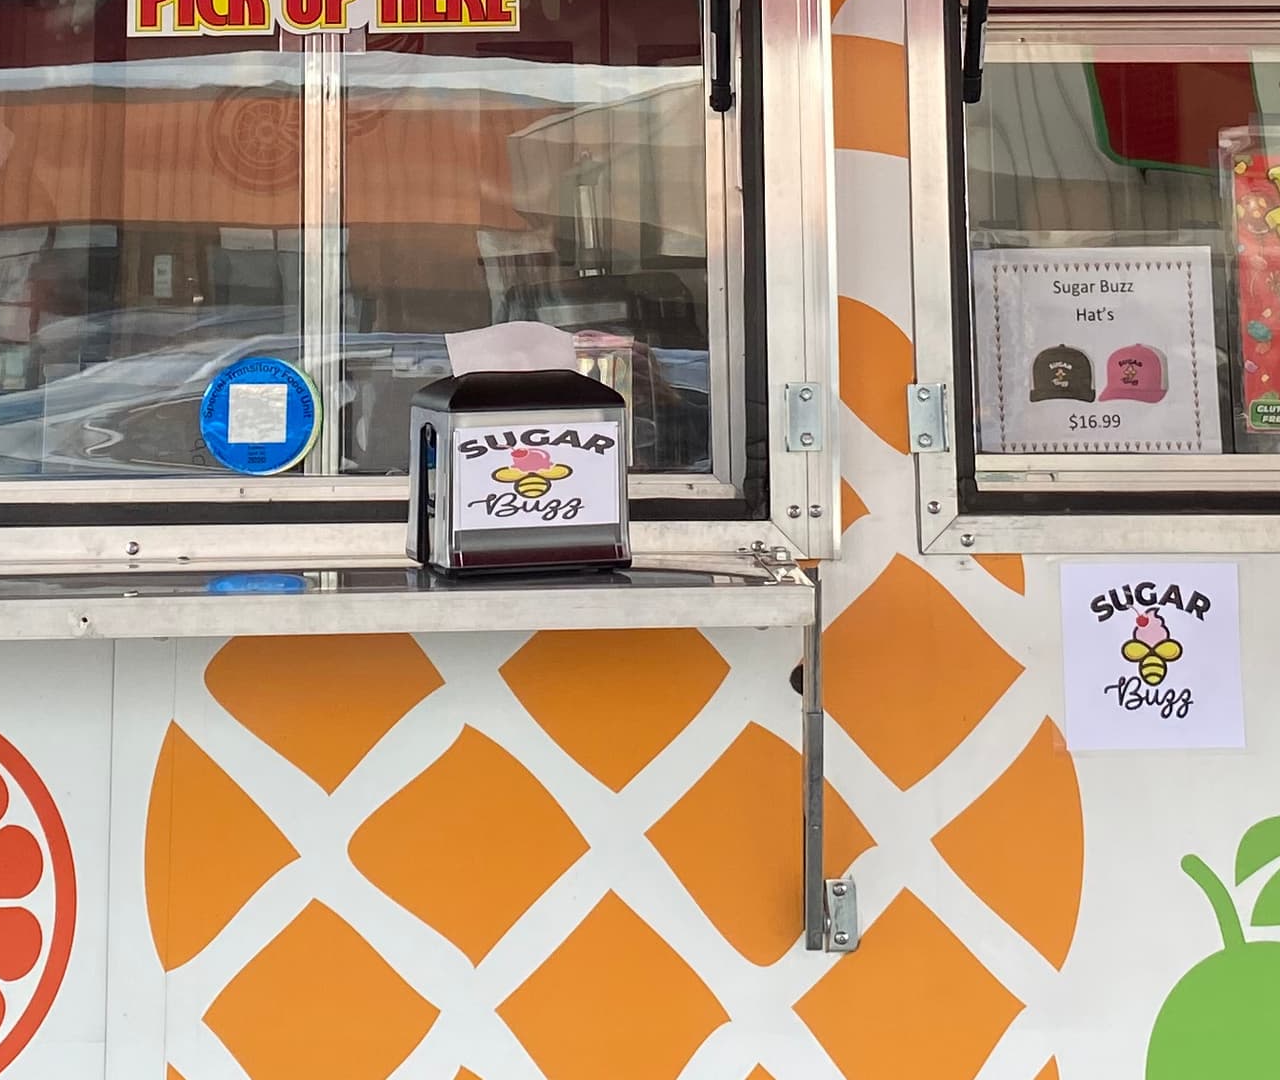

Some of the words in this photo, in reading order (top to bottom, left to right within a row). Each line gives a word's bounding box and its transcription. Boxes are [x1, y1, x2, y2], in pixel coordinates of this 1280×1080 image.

[1053, 280, 1096, 297] Sugar
[1100, 279, 1134, 294] Buzz
[1076, 307, 1115, 322] Hat's
[1049, 361, 1073, 370] SUGAR
[1118, 359, 1143, 368] SUGAR
[203, 379, 228, 419] Special
[224, 363, 281, 381] Transitory
[281, 370, 304, 395] Food
[300, 394, 313, 419] Unit
[1068, 413, 1121, 430] $16.99
[459, 428, 616, 460] SUGAR
[467, 492, 585, 521] Buzz
[1089, 581, 1212, 622] SUGAR
[1103, 675, 1194, 719] Buzz
